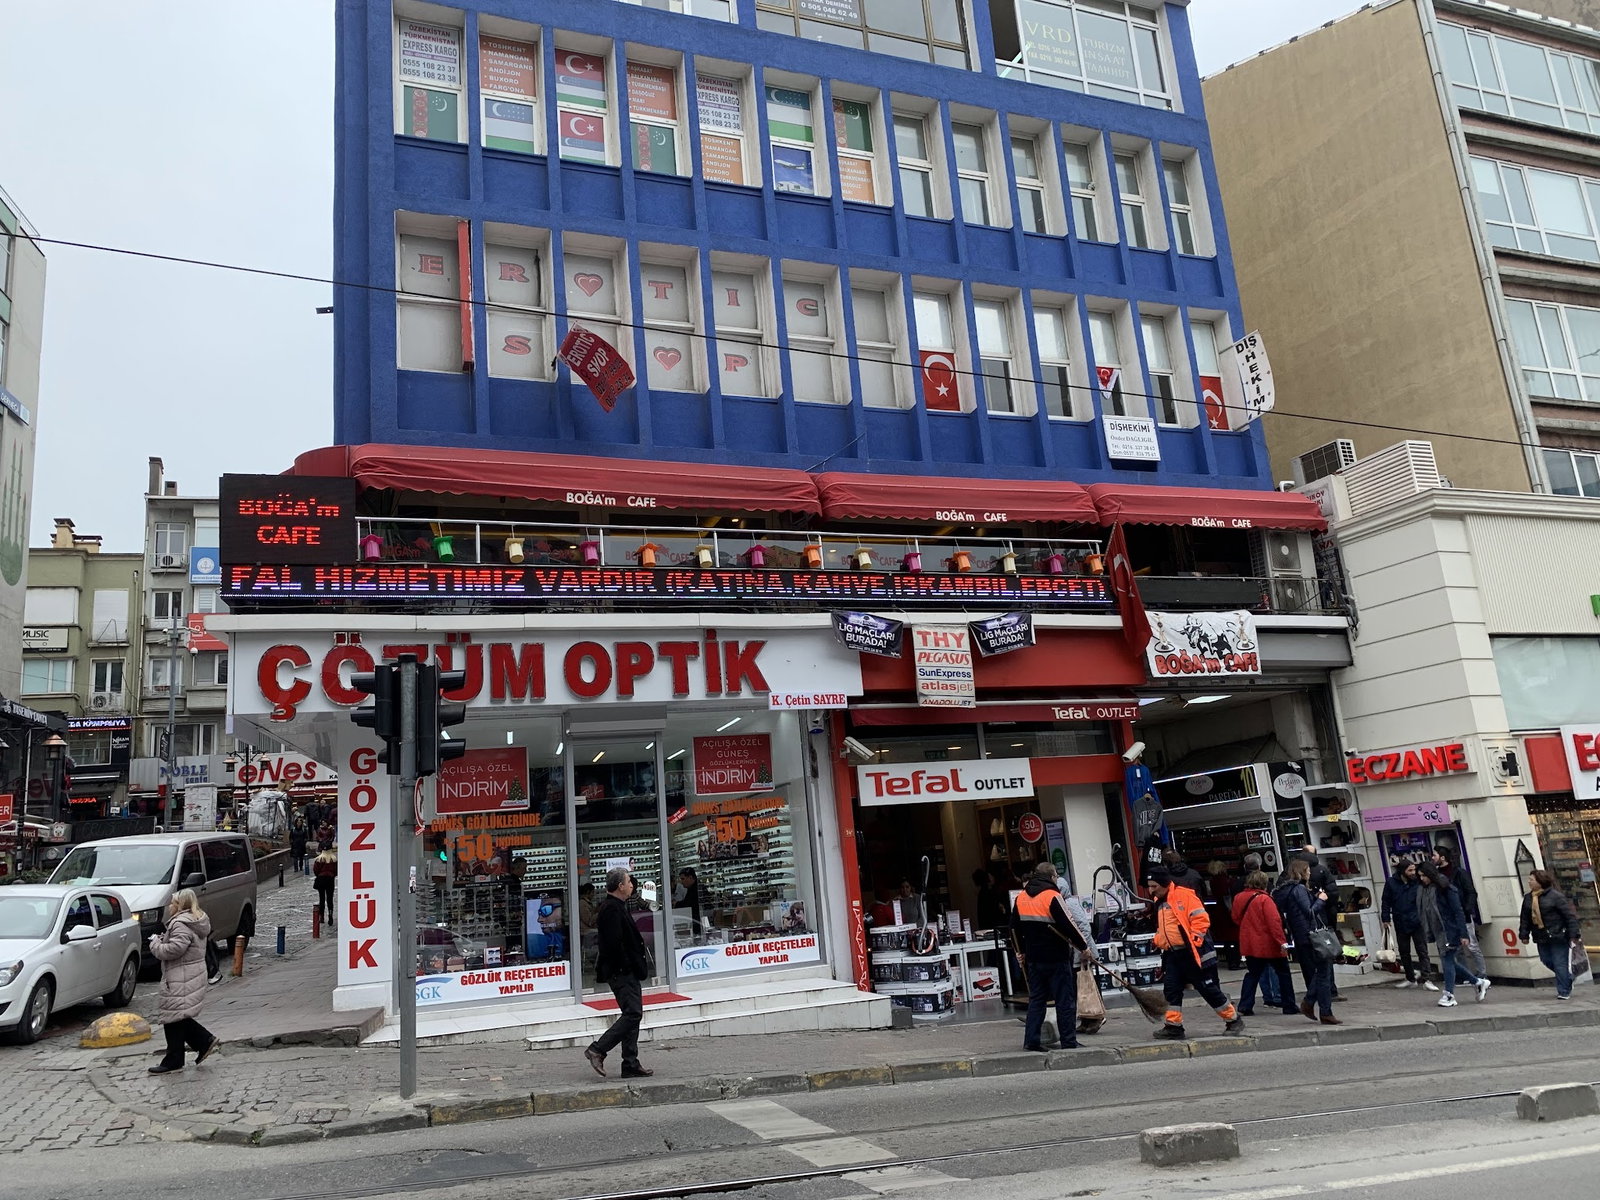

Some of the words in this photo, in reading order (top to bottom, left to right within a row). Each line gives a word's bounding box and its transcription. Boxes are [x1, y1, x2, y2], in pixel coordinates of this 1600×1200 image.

[1025, 20, 1071, 43] VRD
[403, 39, 433, 54] EXPRESS
[434, 44, 458, 57] KARGO
[488, 41, 527, 53] TOSHKENT
[403, 58, 421, 68] 0555
[423, 61, 436, 70] 108
[437, 64, 446, 72] 23
[403, 67, 421, 77] 0555
[423, 70, 436, 79] 108
[437, 73, 446, 81] 23
[489, 75, 519, 85] BUXORO
[698, 91, 719, 102] XPRESS
[567, 334, 595, 367] EROTIC
[1110, 420, 1151, 433] DİŞHEKİMİ
[566, 490, 616, 506] BOĞA'm
[627, 496, 657, 508] CAFE
[936, 509, 976, 522] BOĞA'm
[984, 513, 1008, 522] CAFE
[1192, 516, 1226, 528] BOĞA'm
[1232, 518, 1252, 528] CAFE
[257, 526, 321, 545] CAFE
[231, 567, 301, 590] FAL
[845, 632, 887, 648] BURADA!
[855, 625, 895, 641] MAÇLARI
[915, 630, 966, 649] THY
[989, 632, 1025, 648] BURADA!
[917, 651, 970, 665] PEGASUS
[1154, 649, 1221, 675] BOĞA'm
[1223, 652, 1259, 673] CAFE
[257, 631, 547, 723] ÇÖÜM
[563, 628, 773, 699] OPTİK
[918, 668, 972, 679] SunExpress
[921, 681, 973, 694] atlasjet
[771, 694, 783, 706] K.
[785, 694, 811, 707] Çetin
[813, 693, 847, 706] SAYRE
[1052, 706, 1090, 720] Tefal
[1097, 706, 1138, 719] OUTLET
[702, 739, 737, 749] AÇILIŞA
[740, 737, 763, 747] ÖZEL
[442, 766, 484, 776] AÇILIŞA
[487, 763, 514, 772] ÖZEL
[1347, 743, 1469, 784] ECZANE
[701, 764, 756, 786] İNDİRİM
[441, 775, 509, 799] İNDİRİM
[865, 768, 967, 799] Tefal
[975, 777, 1025, 791] OUTLET
[348, 747, 379, 970] GÖZLÜK
[725, 943, 761, 957] GÖZLÜK
[763, 934, 816, 953] REÇETELERİ
[685, 957, 710, 971] SGK
[758, 953, 789, 965] YAPILIR
[460, 971, 502, 986] GÖZLÜK
[504, 962, 566, 983] REÇETELERİ
[498, 983, 534, 996] YAPILIR
